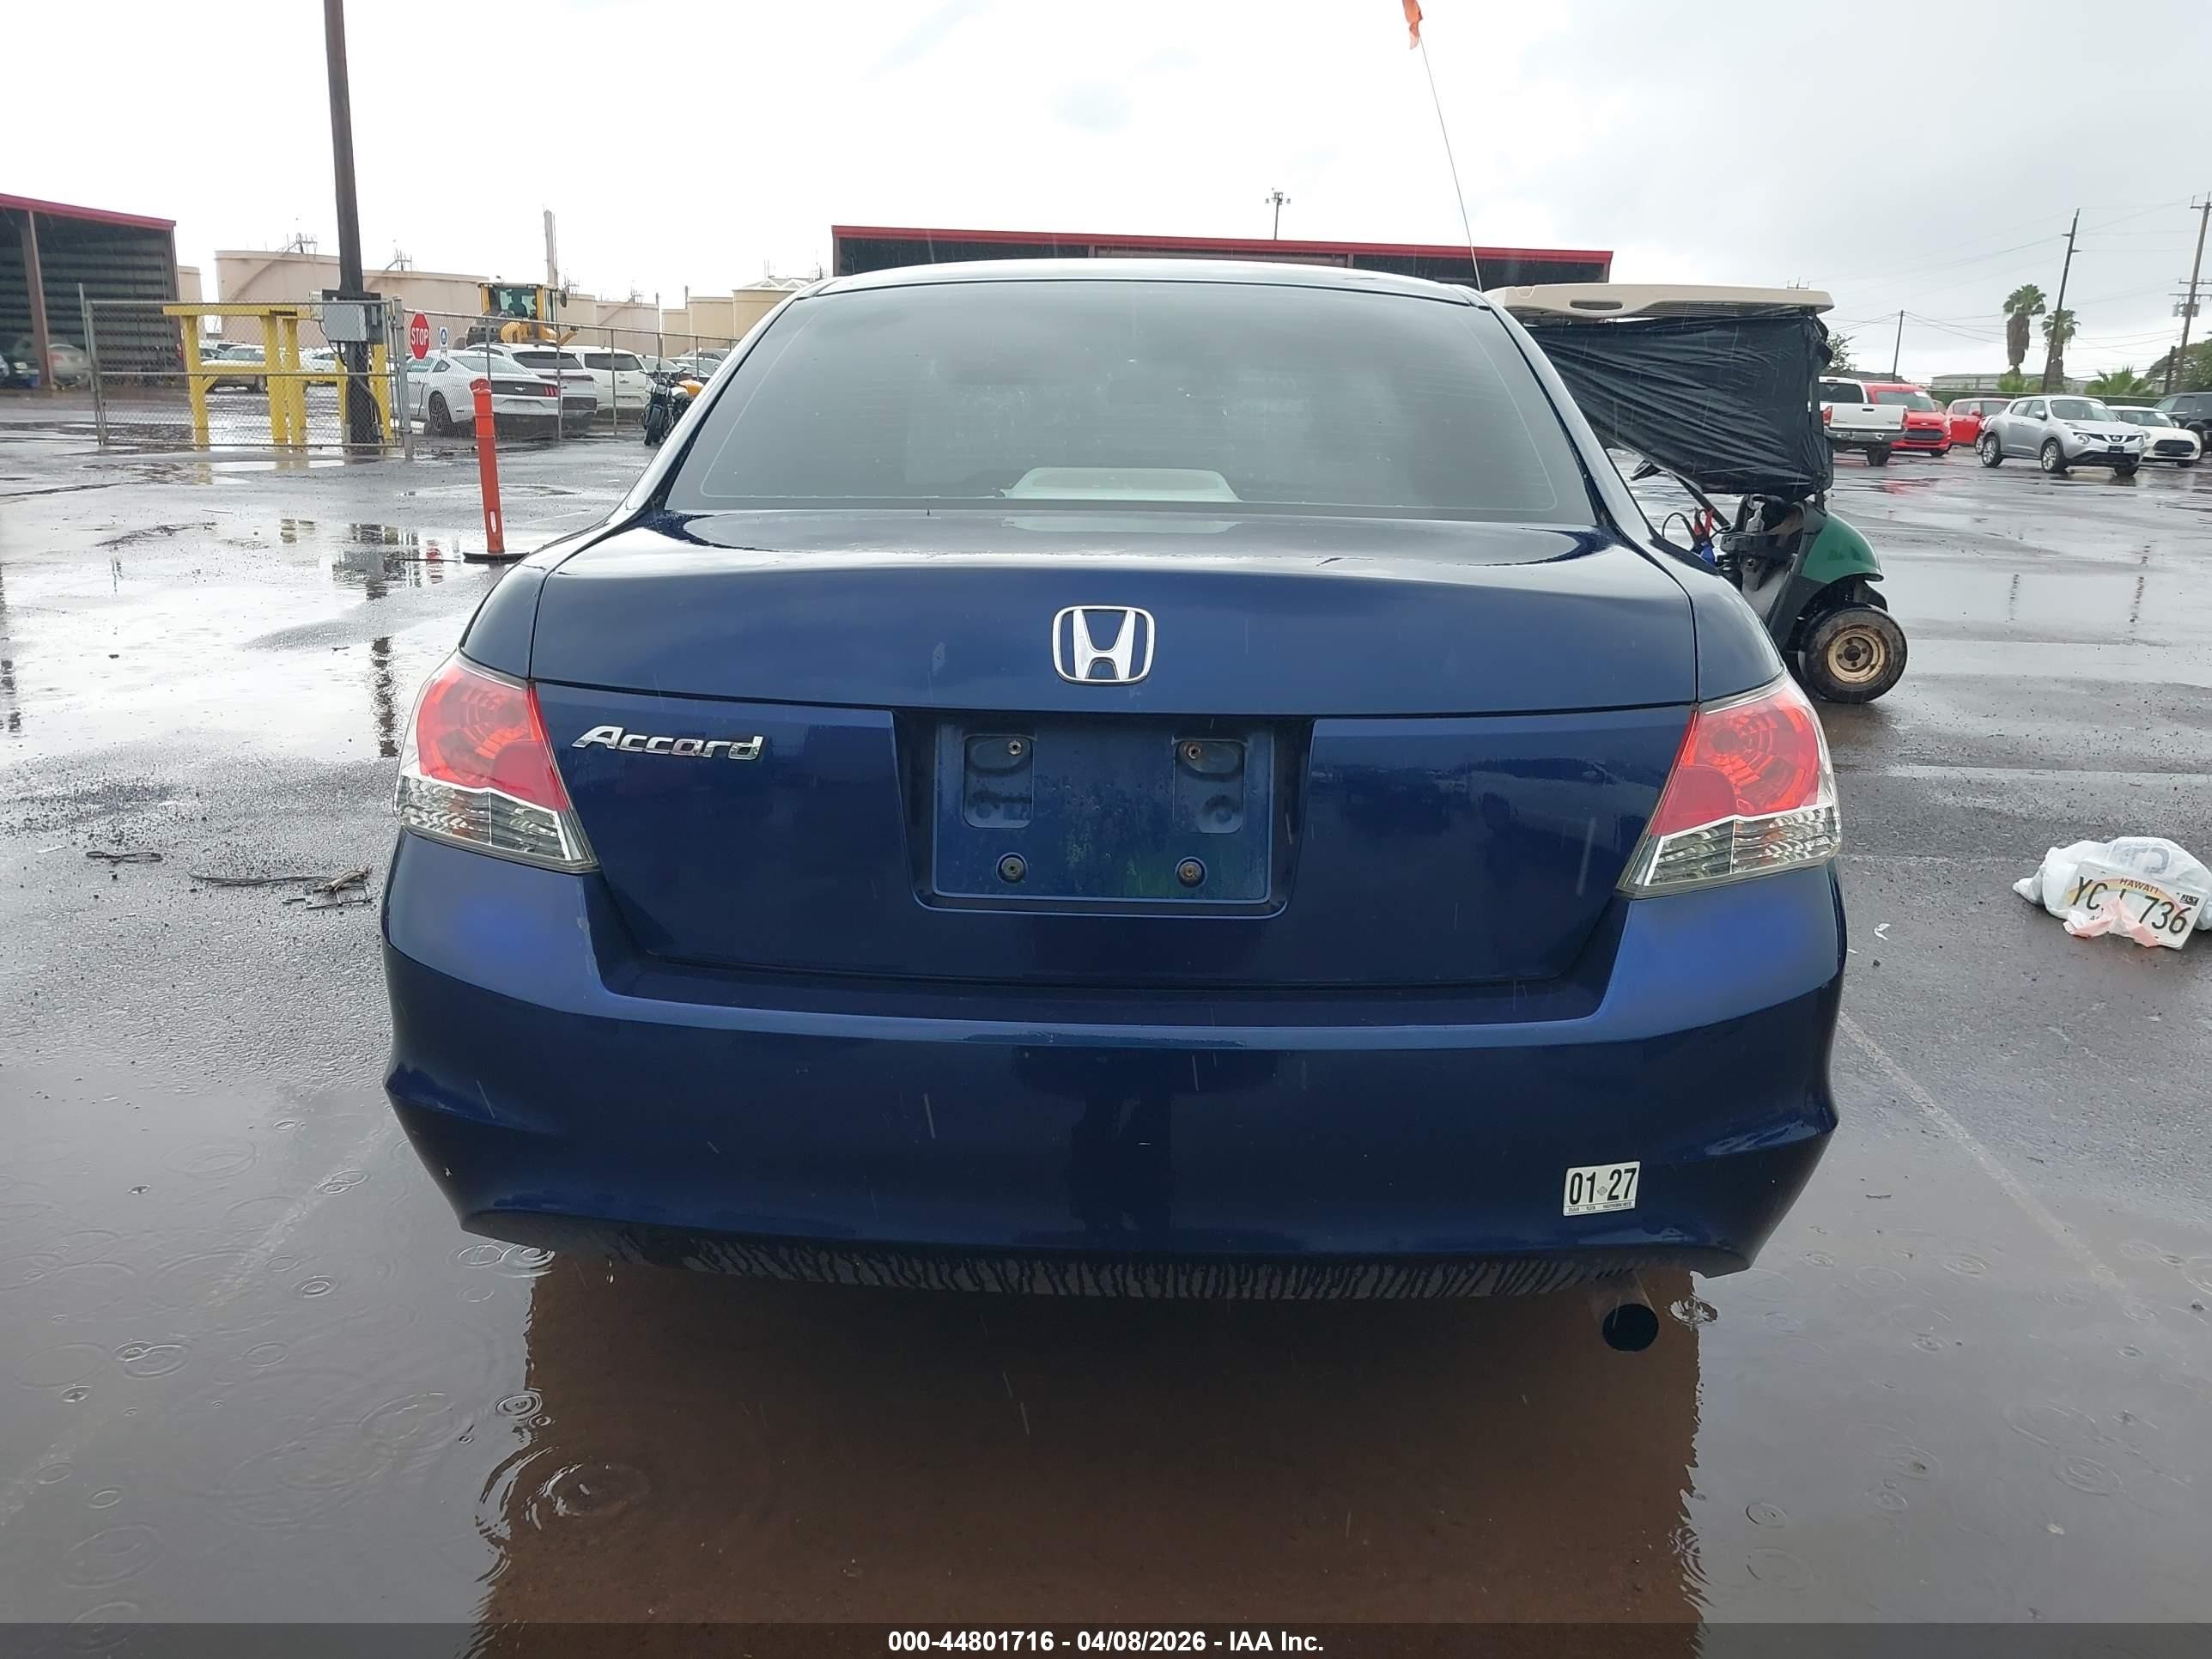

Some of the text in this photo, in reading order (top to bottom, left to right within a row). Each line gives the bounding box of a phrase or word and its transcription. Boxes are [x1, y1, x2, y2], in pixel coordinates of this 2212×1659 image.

[411, 327, 428, 346] STOP
[571, 725, 763, 761] Accord
[2069, 876, 2191, 934] YC 736
[1569, 1167, 1638, 1205] 01 27
